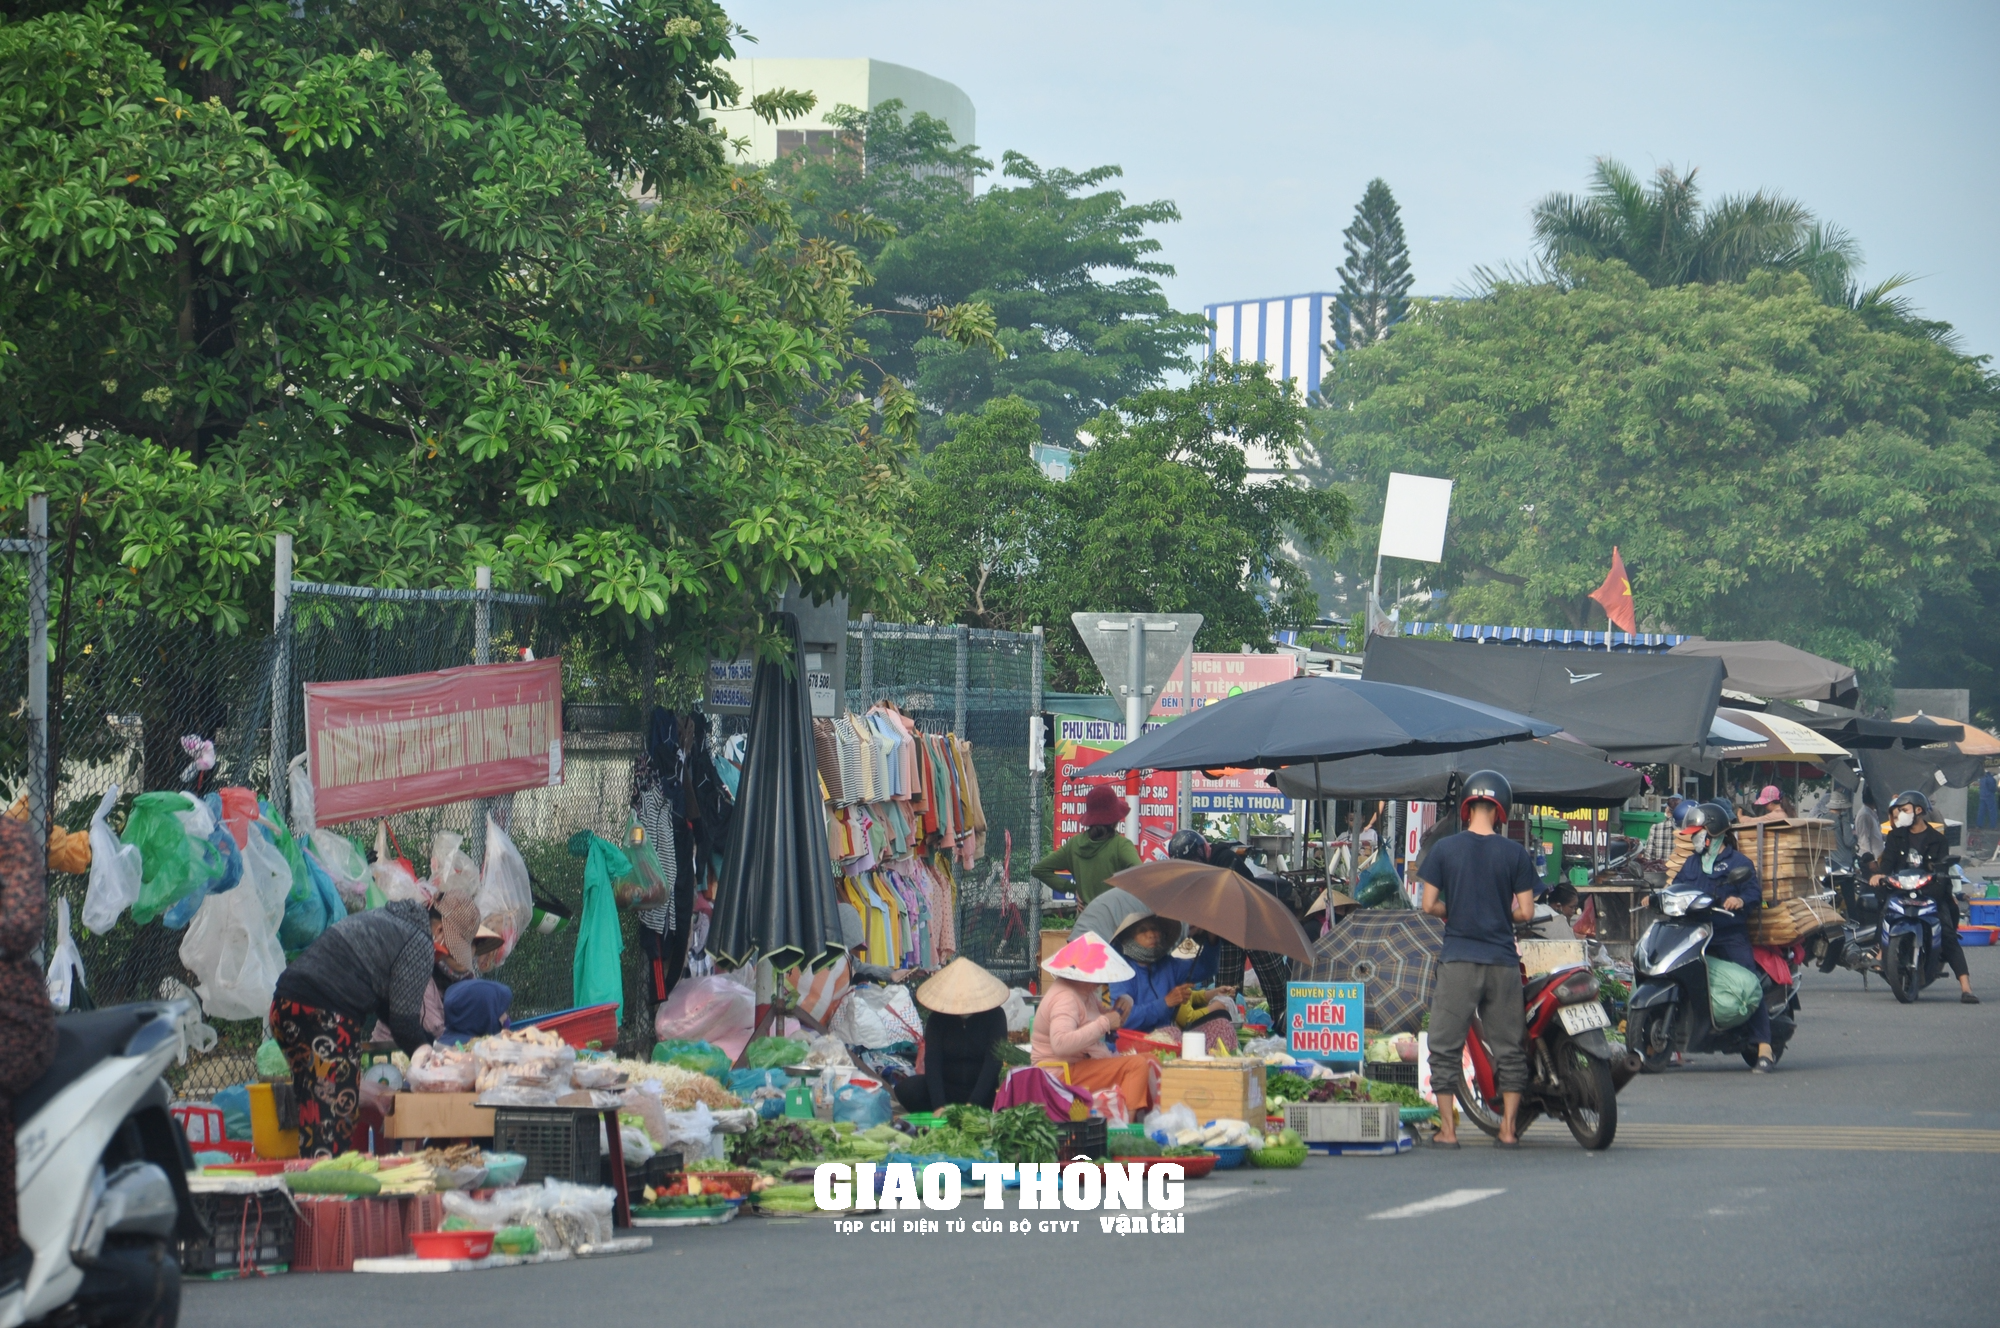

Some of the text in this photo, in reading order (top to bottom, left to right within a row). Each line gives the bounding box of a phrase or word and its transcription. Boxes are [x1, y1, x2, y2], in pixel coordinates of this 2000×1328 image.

[1226, 660, 1245, 676] VỤ
[1161, 695, 1178, 708] ĐẾN
[1062, 721, 1083, 744] PHỤ
[1086, 719, 1111, 744] KIỆN
[1152, 786, 1168, 801] SẠC
[1062, 803, 1075, 815] PIN
[1213, 794, 1243, 811] ĐIỆN
[1247, 796, 1285, 812] THOẠI
[1061, 819, 1077, 833] DÁN
[1562, 825, 1581, 845] GIẢI
[1290, 987, 1324, 998] CHUYÊN
[1338, 988, 1345, 998] &
[1306, 999, 1345, 1025] HẾN
[1292, 1014, 1304, 1029] &
[1570, 1015, 1603, 1032] 5763
[1292, 1027, 1359, 1056] NHỘNG
